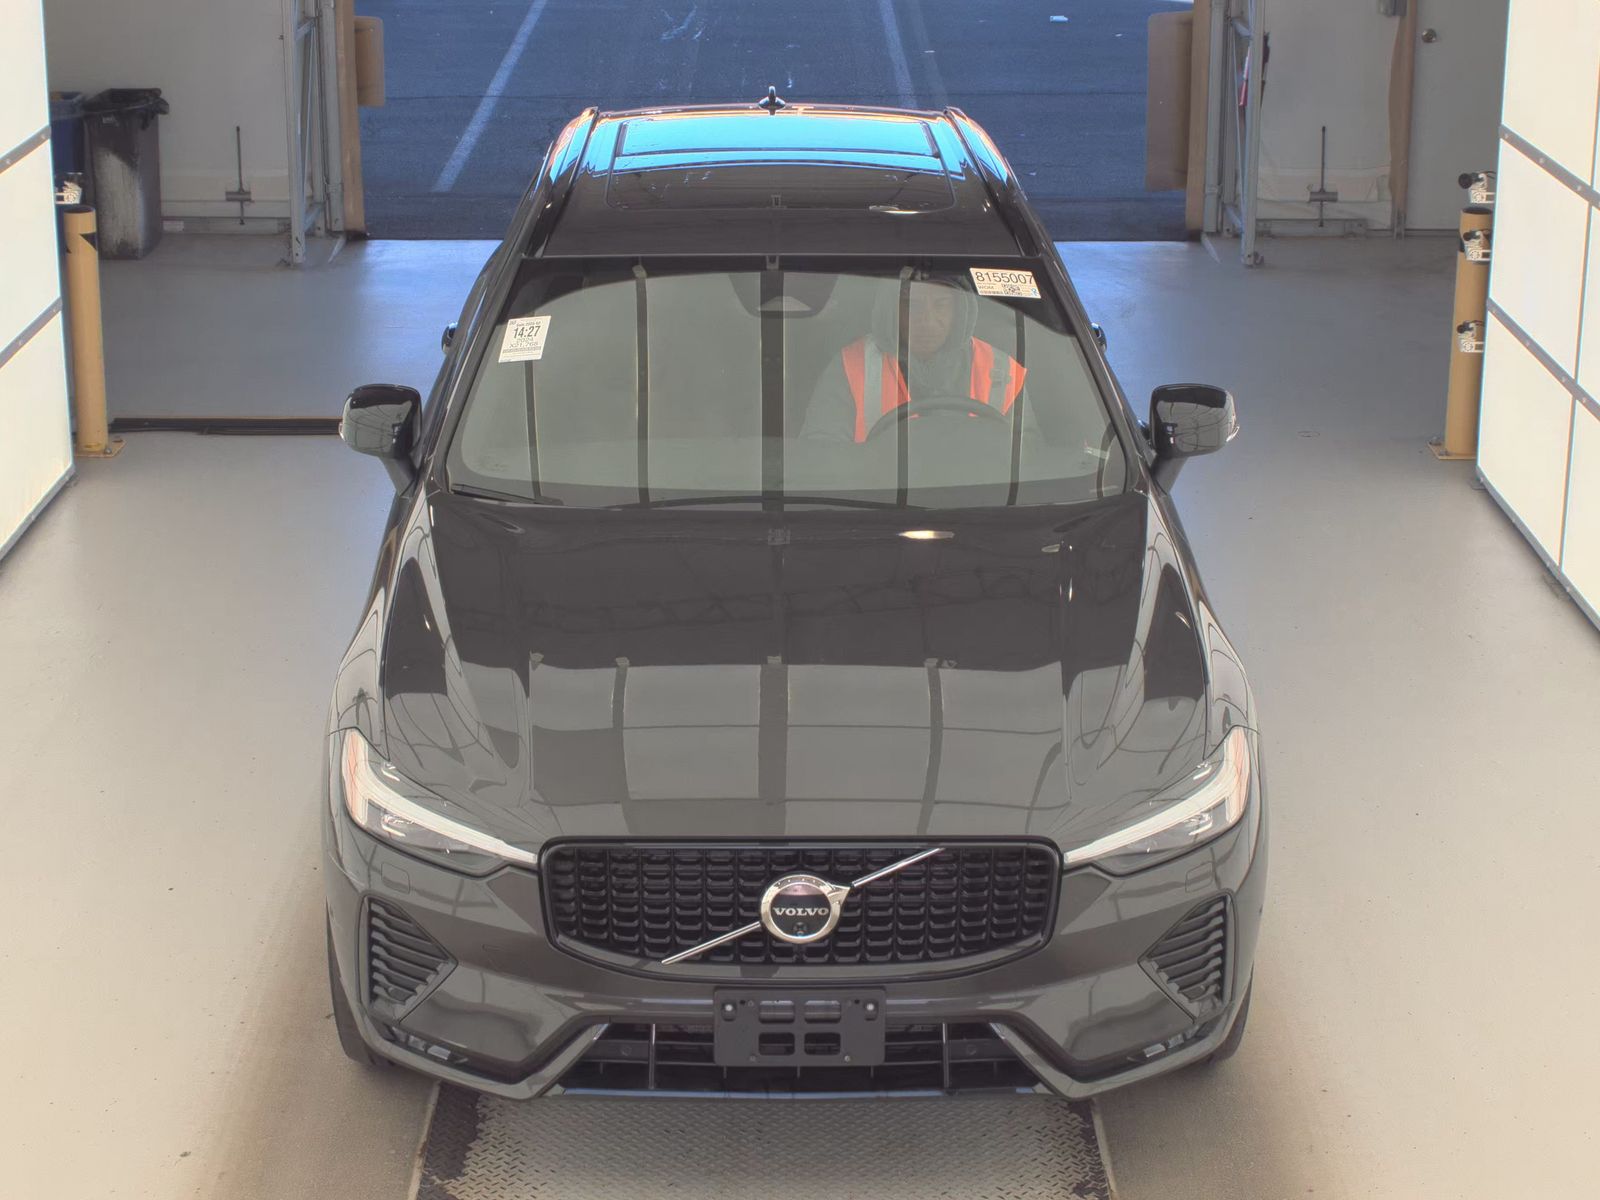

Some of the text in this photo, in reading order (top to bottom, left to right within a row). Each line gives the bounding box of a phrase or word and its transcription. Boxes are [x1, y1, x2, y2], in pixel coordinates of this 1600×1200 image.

[975, 271, 1033, 284] 8155007
[513, 325, 541, 339] 14:27
[773, 907, 829, 916] VOLVO
